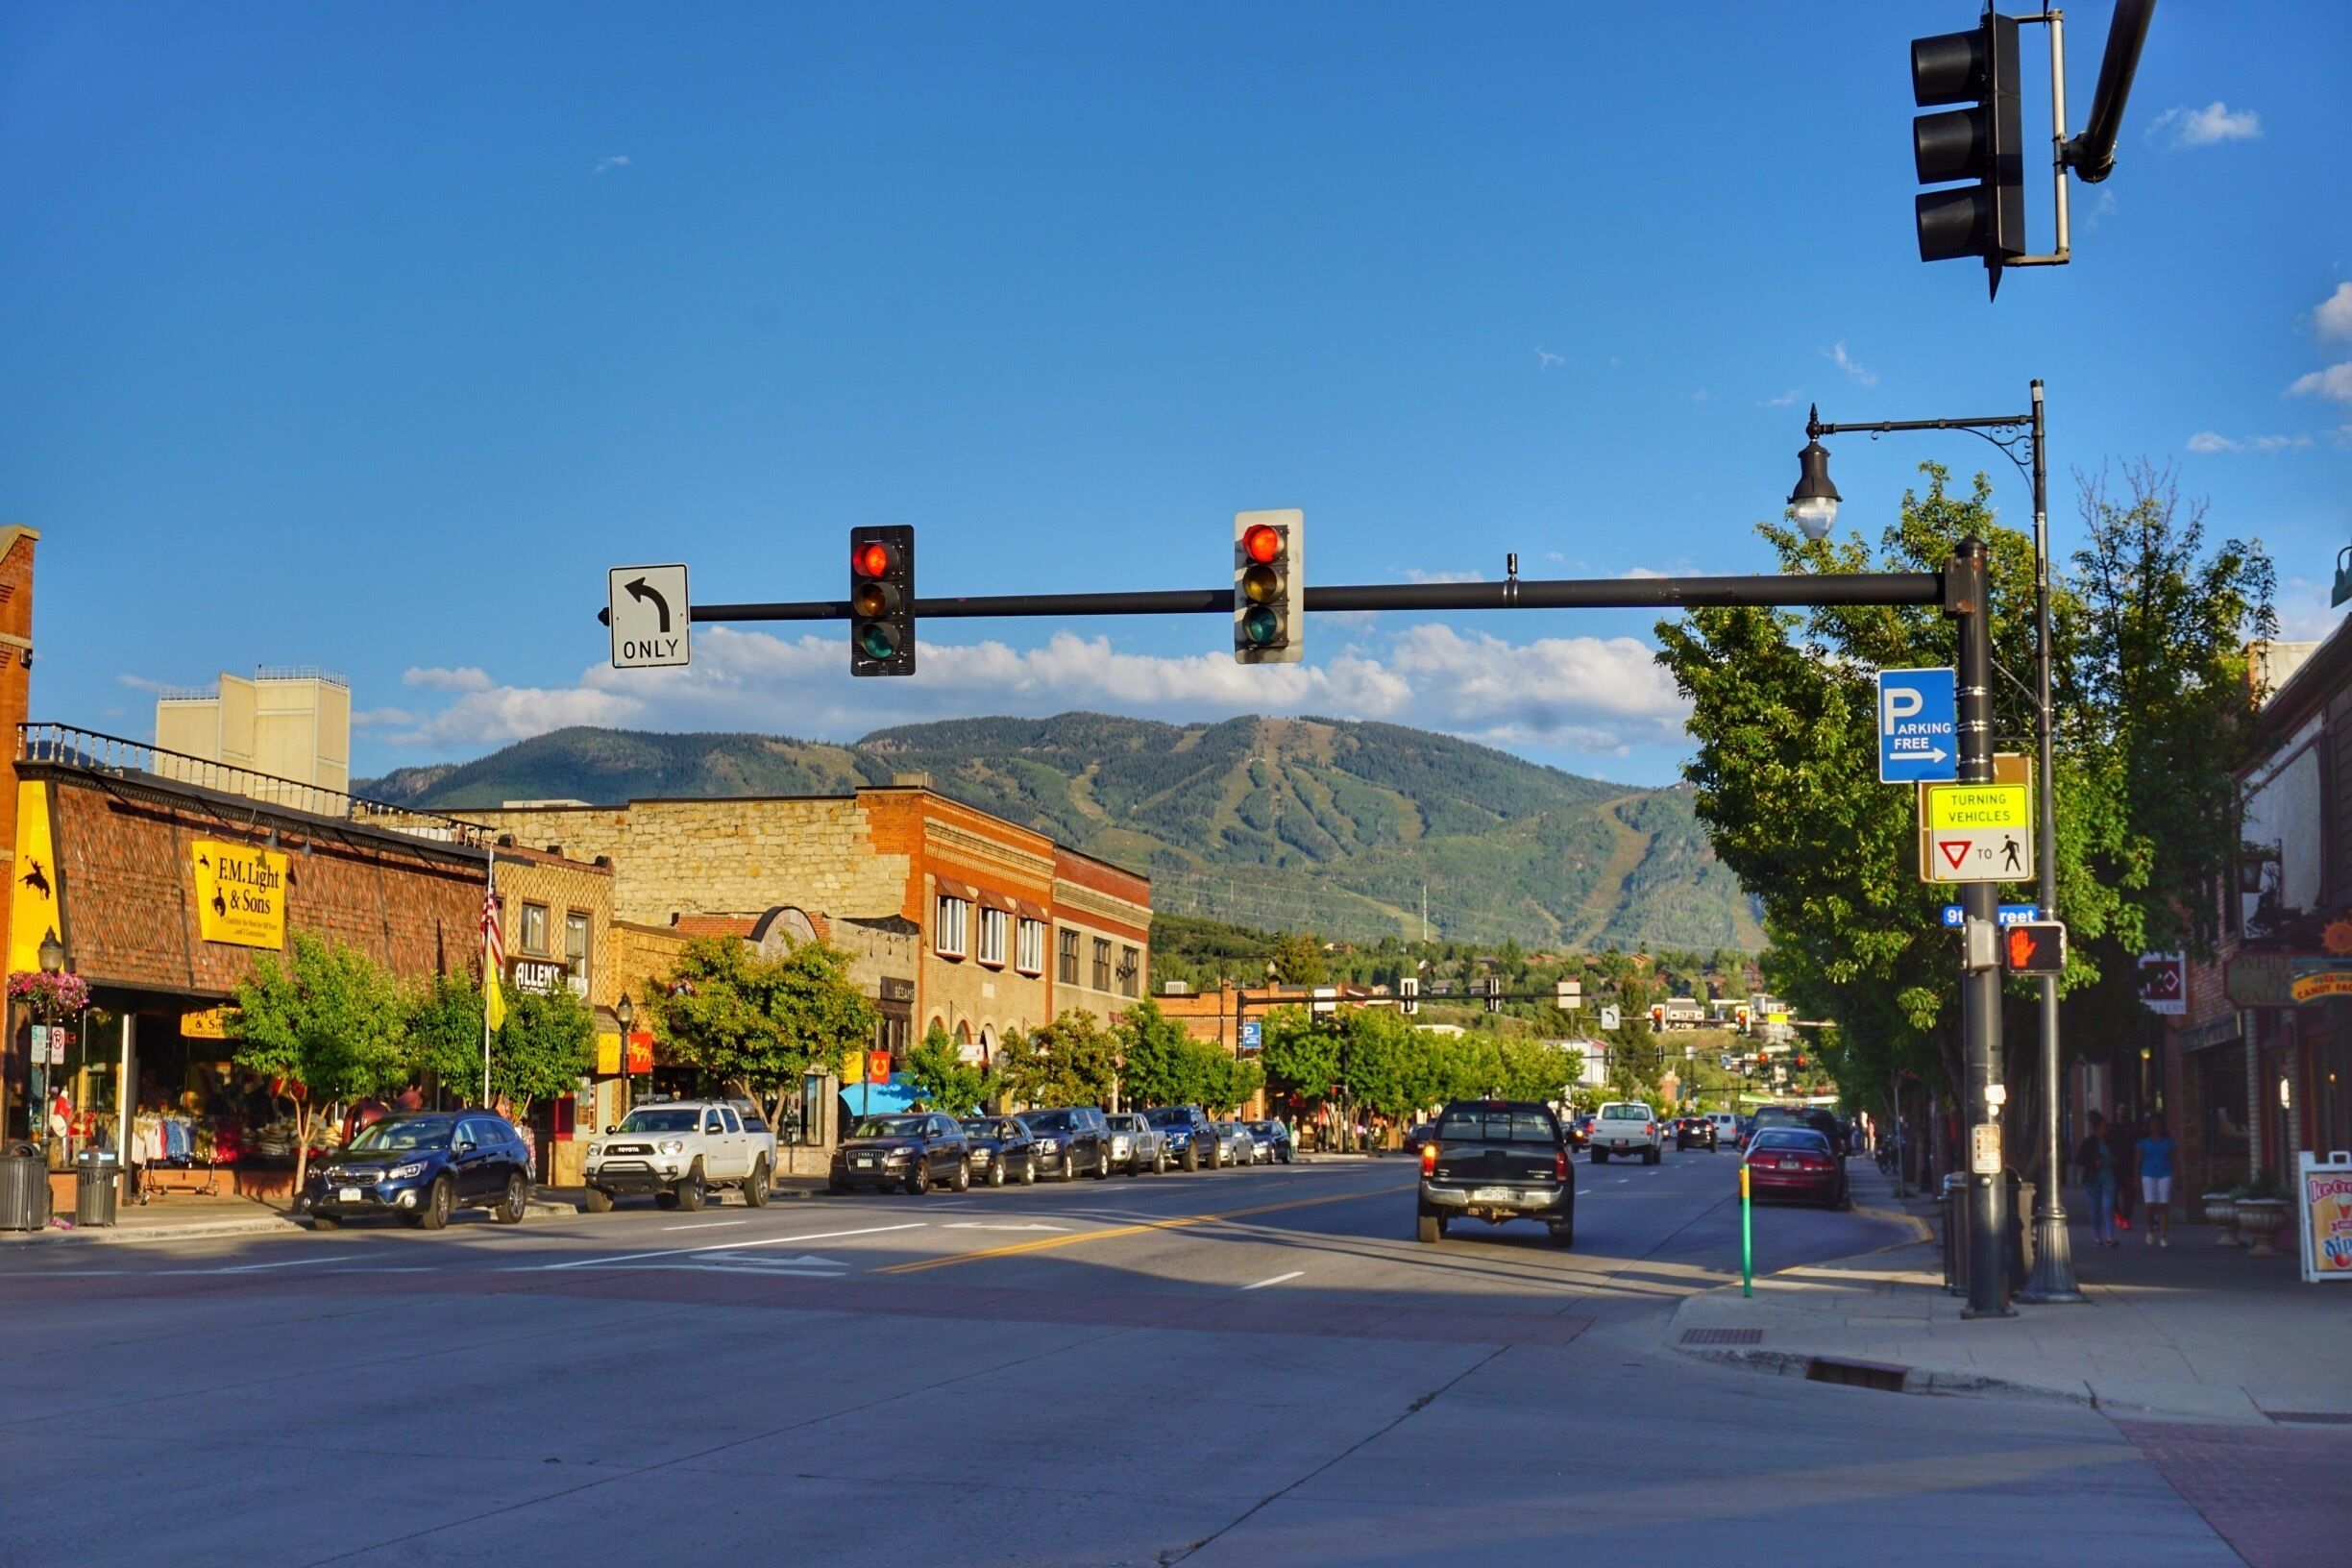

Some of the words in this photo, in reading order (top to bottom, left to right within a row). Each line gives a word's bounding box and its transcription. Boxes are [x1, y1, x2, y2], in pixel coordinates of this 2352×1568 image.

[624, 639, 678, 659] ONLY
[1895, 738, 1929, 749] FREE
[1951, 794, 2007, 805] TURNING
[1948, 811, 2011, 822] VEHICLES
[1976, 849, 1992, 860] TO
[219, 857, 246, 883] F.M.
[248, 862, 280, 894] Light
[231, 890, 240, 910] &
[243, 889, 271, 915] Sons
[1948, 909, 1964, 923] 9t
[1999, 909, 2035, 923] reet
[516, 963, 560, 990] ALLEN'S
[2297, 983, 2331, 999] CANDY
[195, 1019, 203, 1029] &
